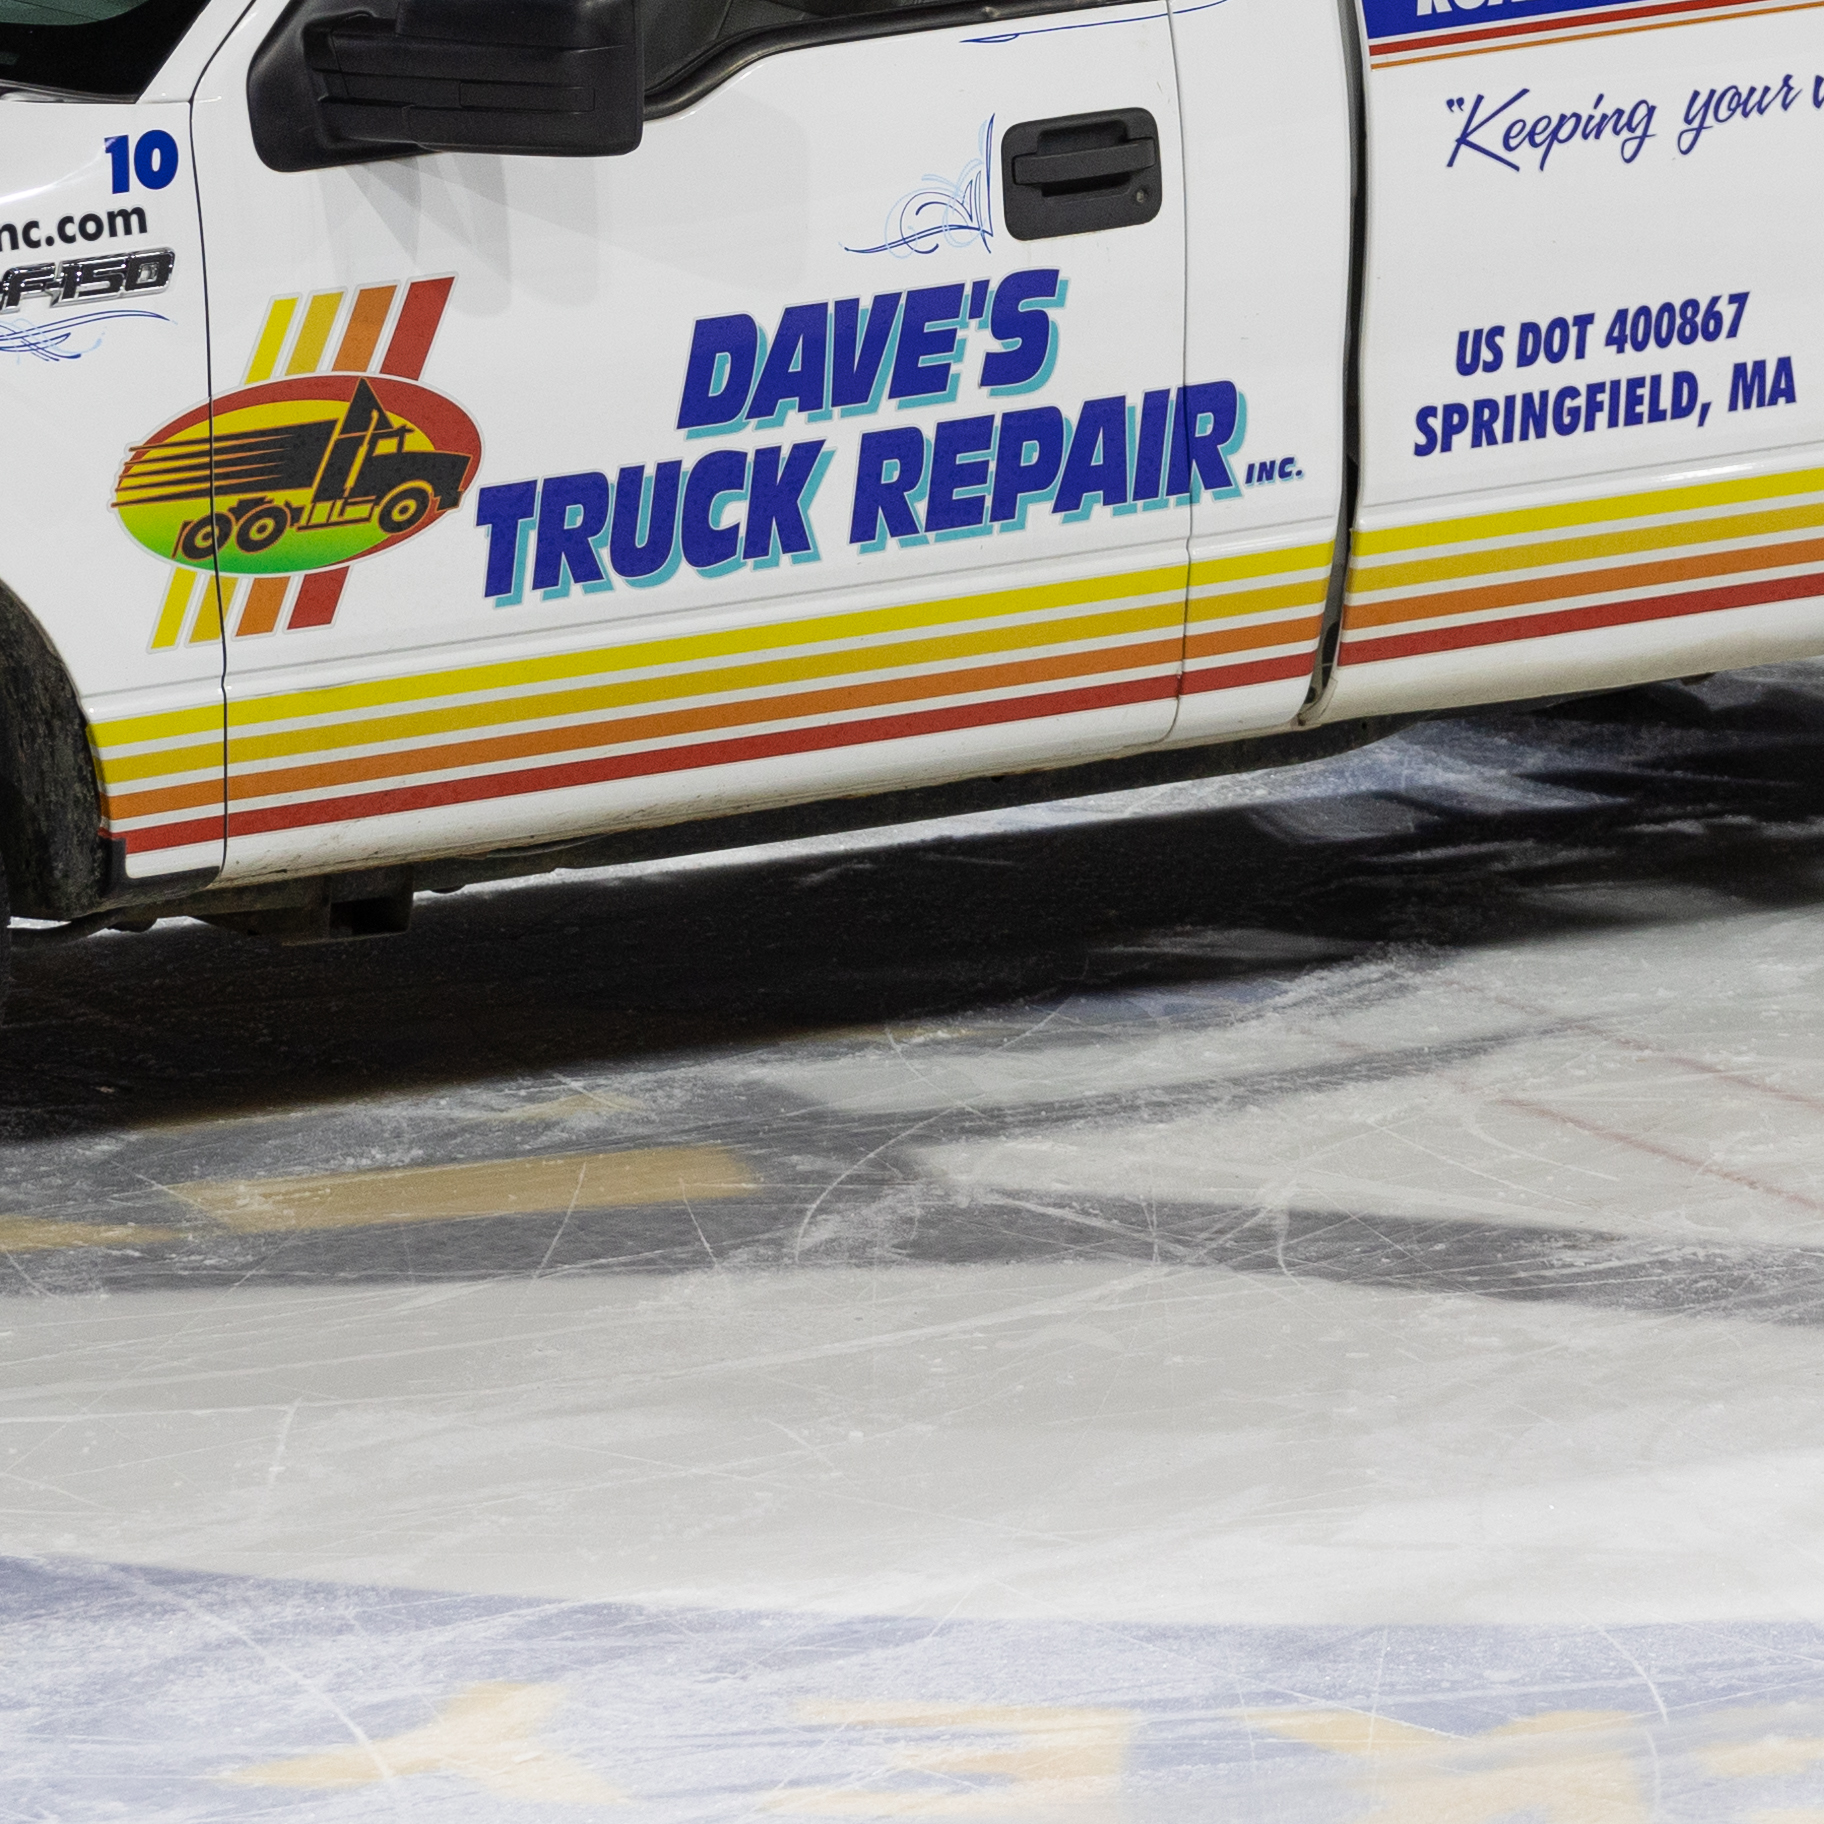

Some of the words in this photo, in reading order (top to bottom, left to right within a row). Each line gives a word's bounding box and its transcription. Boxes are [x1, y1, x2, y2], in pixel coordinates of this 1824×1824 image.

[102, 128, 181, 196] 10
[1677, 72, 1805, 157] your
[673, 267, 1064, 438] DAVE'S
[1454, 324, 1507, 378] US
[1514, 311, 1597, 369] DOT
[1603, 289, 1752, 356] 400867
[1412, 369, 1714, 458] SPRINGFIELD,
[1726, 354, 1798, 414] MA
[472, 440, 830, 606] TRUCK
[846, 378, 1245, 554] REPAIR
[1244, 453, 1307, 487] INC.
